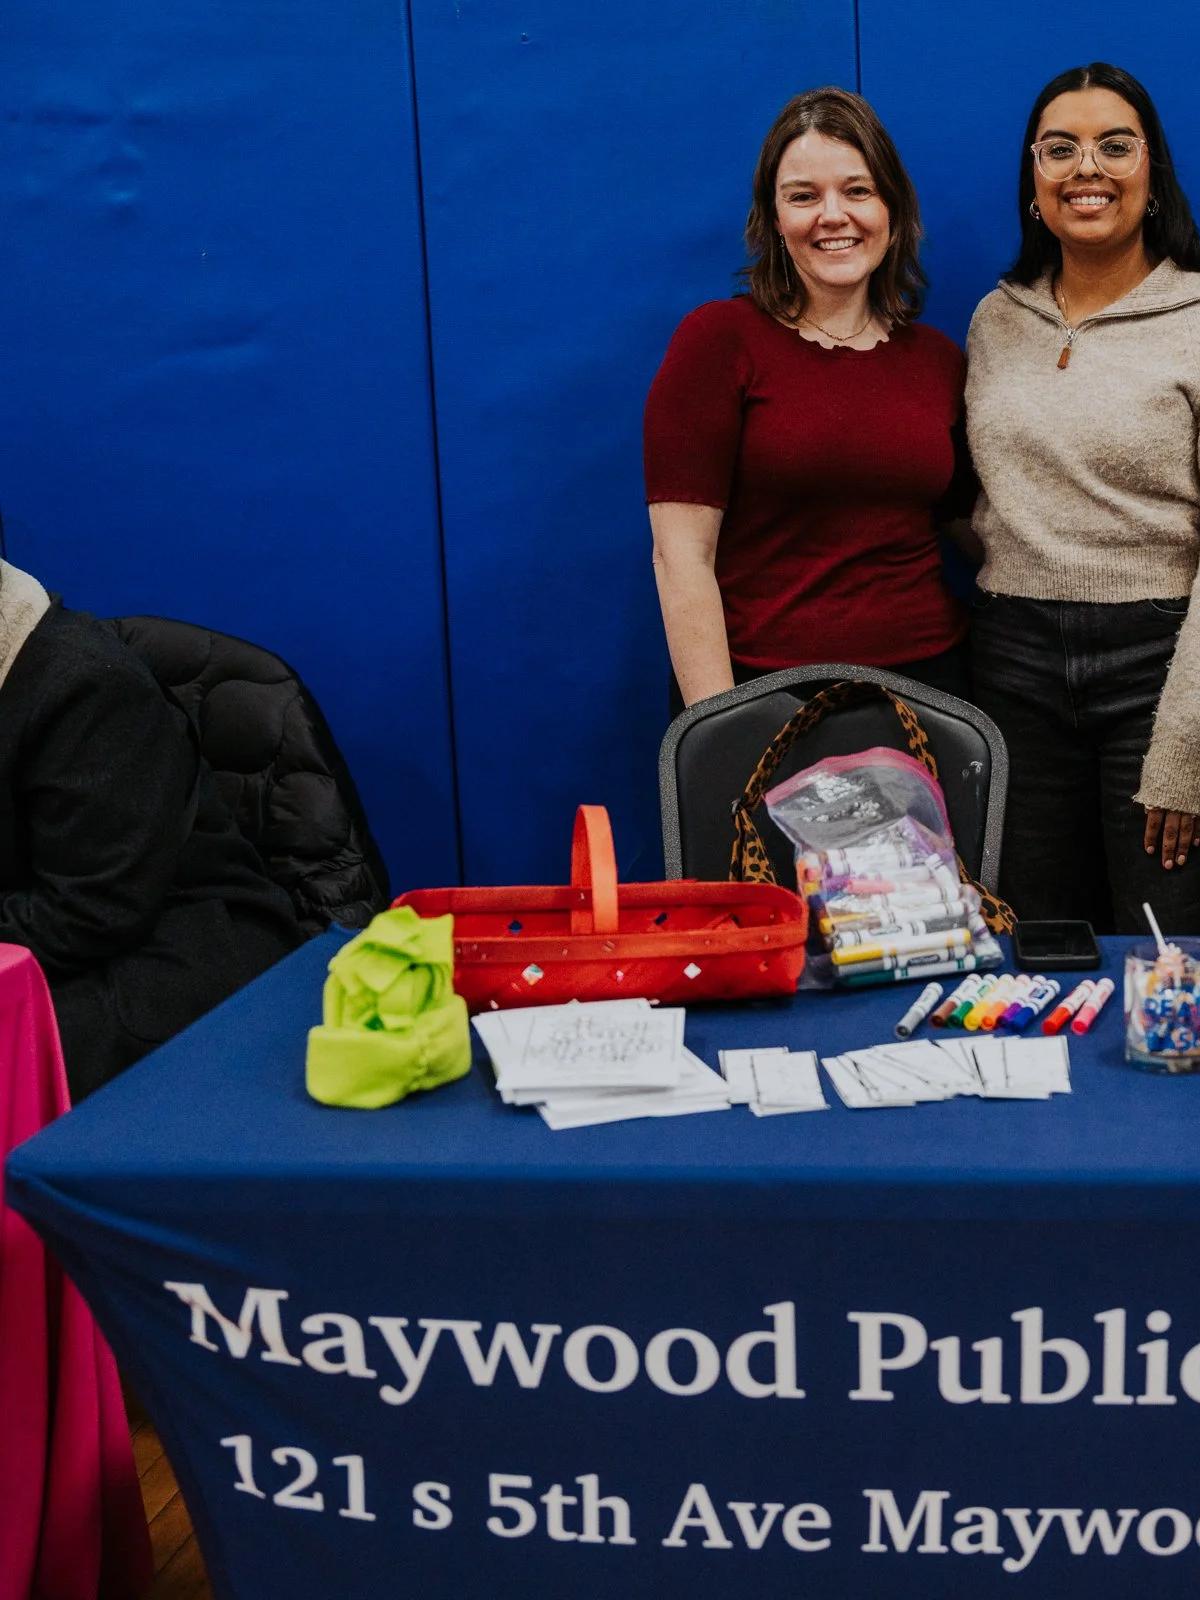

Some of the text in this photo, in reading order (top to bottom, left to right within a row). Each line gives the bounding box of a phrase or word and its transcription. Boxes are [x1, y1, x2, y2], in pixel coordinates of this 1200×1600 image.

[164, 1281, 806, 1405] Maywood
[220, 1435, 376, 1521] 121
[413, 1481, 453, 1530] s
[487, 1473, 637, 1545] 5th
[662, 1483, 831, 1552] Ave
